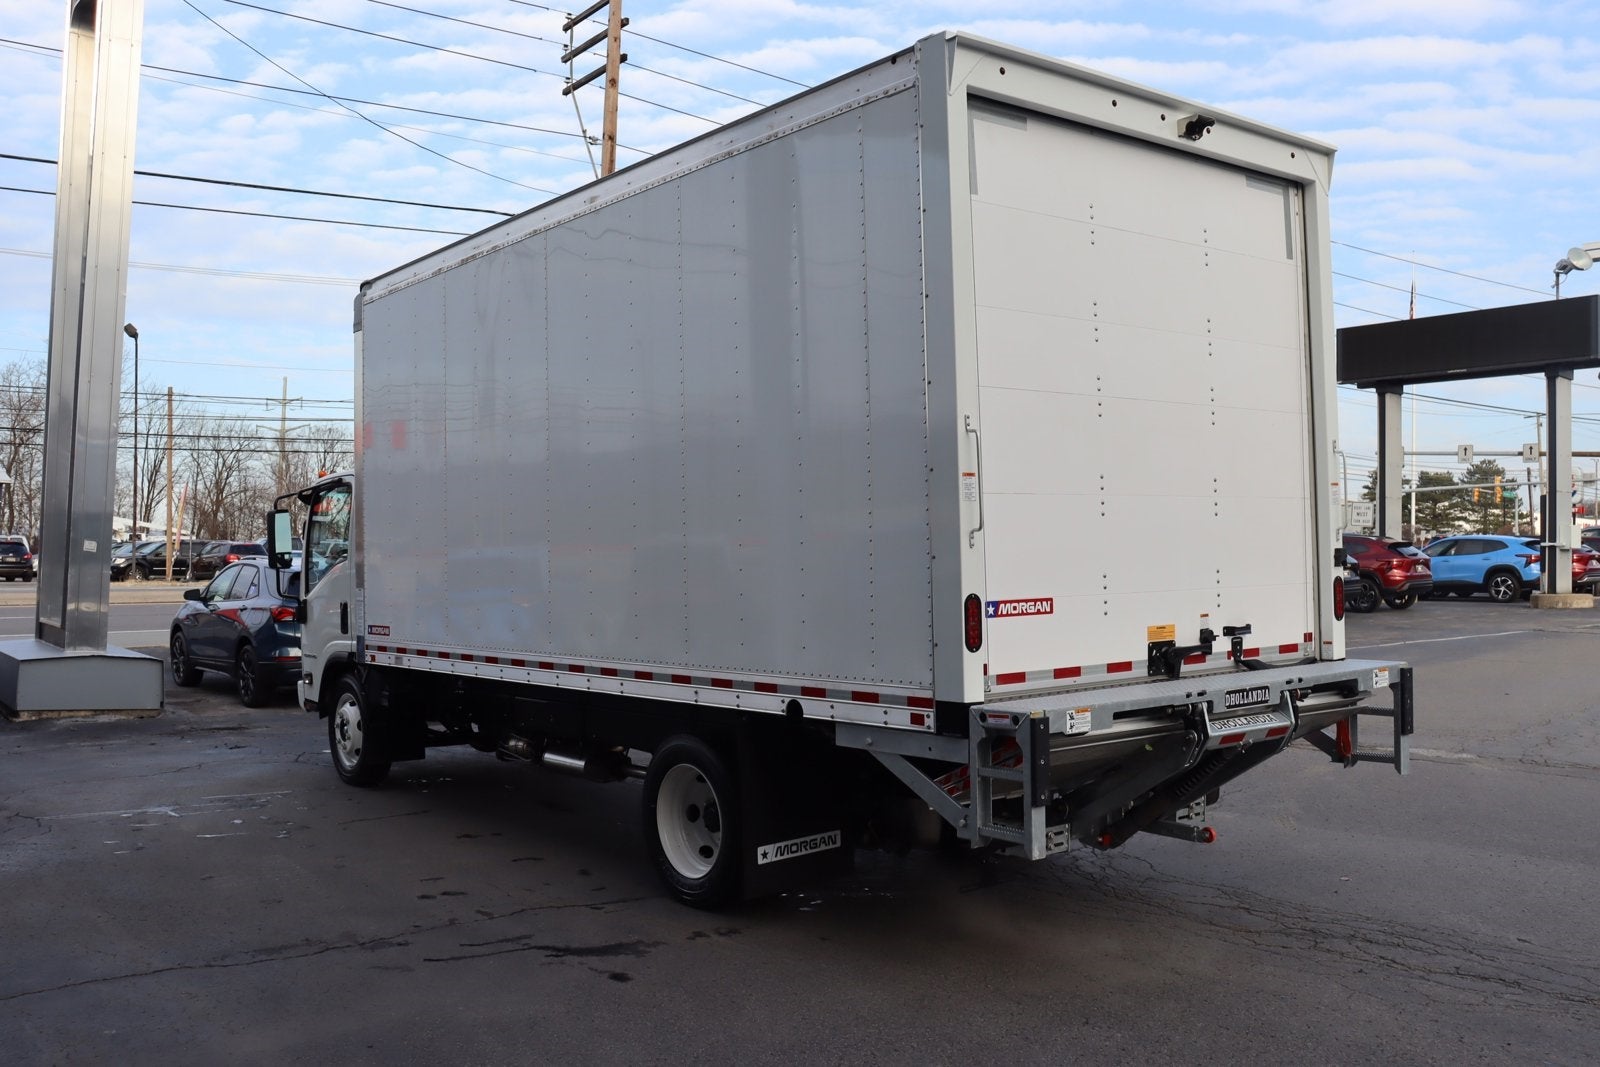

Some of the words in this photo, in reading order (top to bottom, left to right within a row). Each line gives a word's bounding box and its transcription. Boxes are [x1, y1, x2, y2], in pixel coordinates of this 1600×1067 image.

[998, 601, 1051, 615] MORGAN
[1225, 689, 1270, 707] DHOLLANDIA
[1212, 714, 1277, 730] DHOLLANDIA
[774, 834, 837, 858] MORGAN
